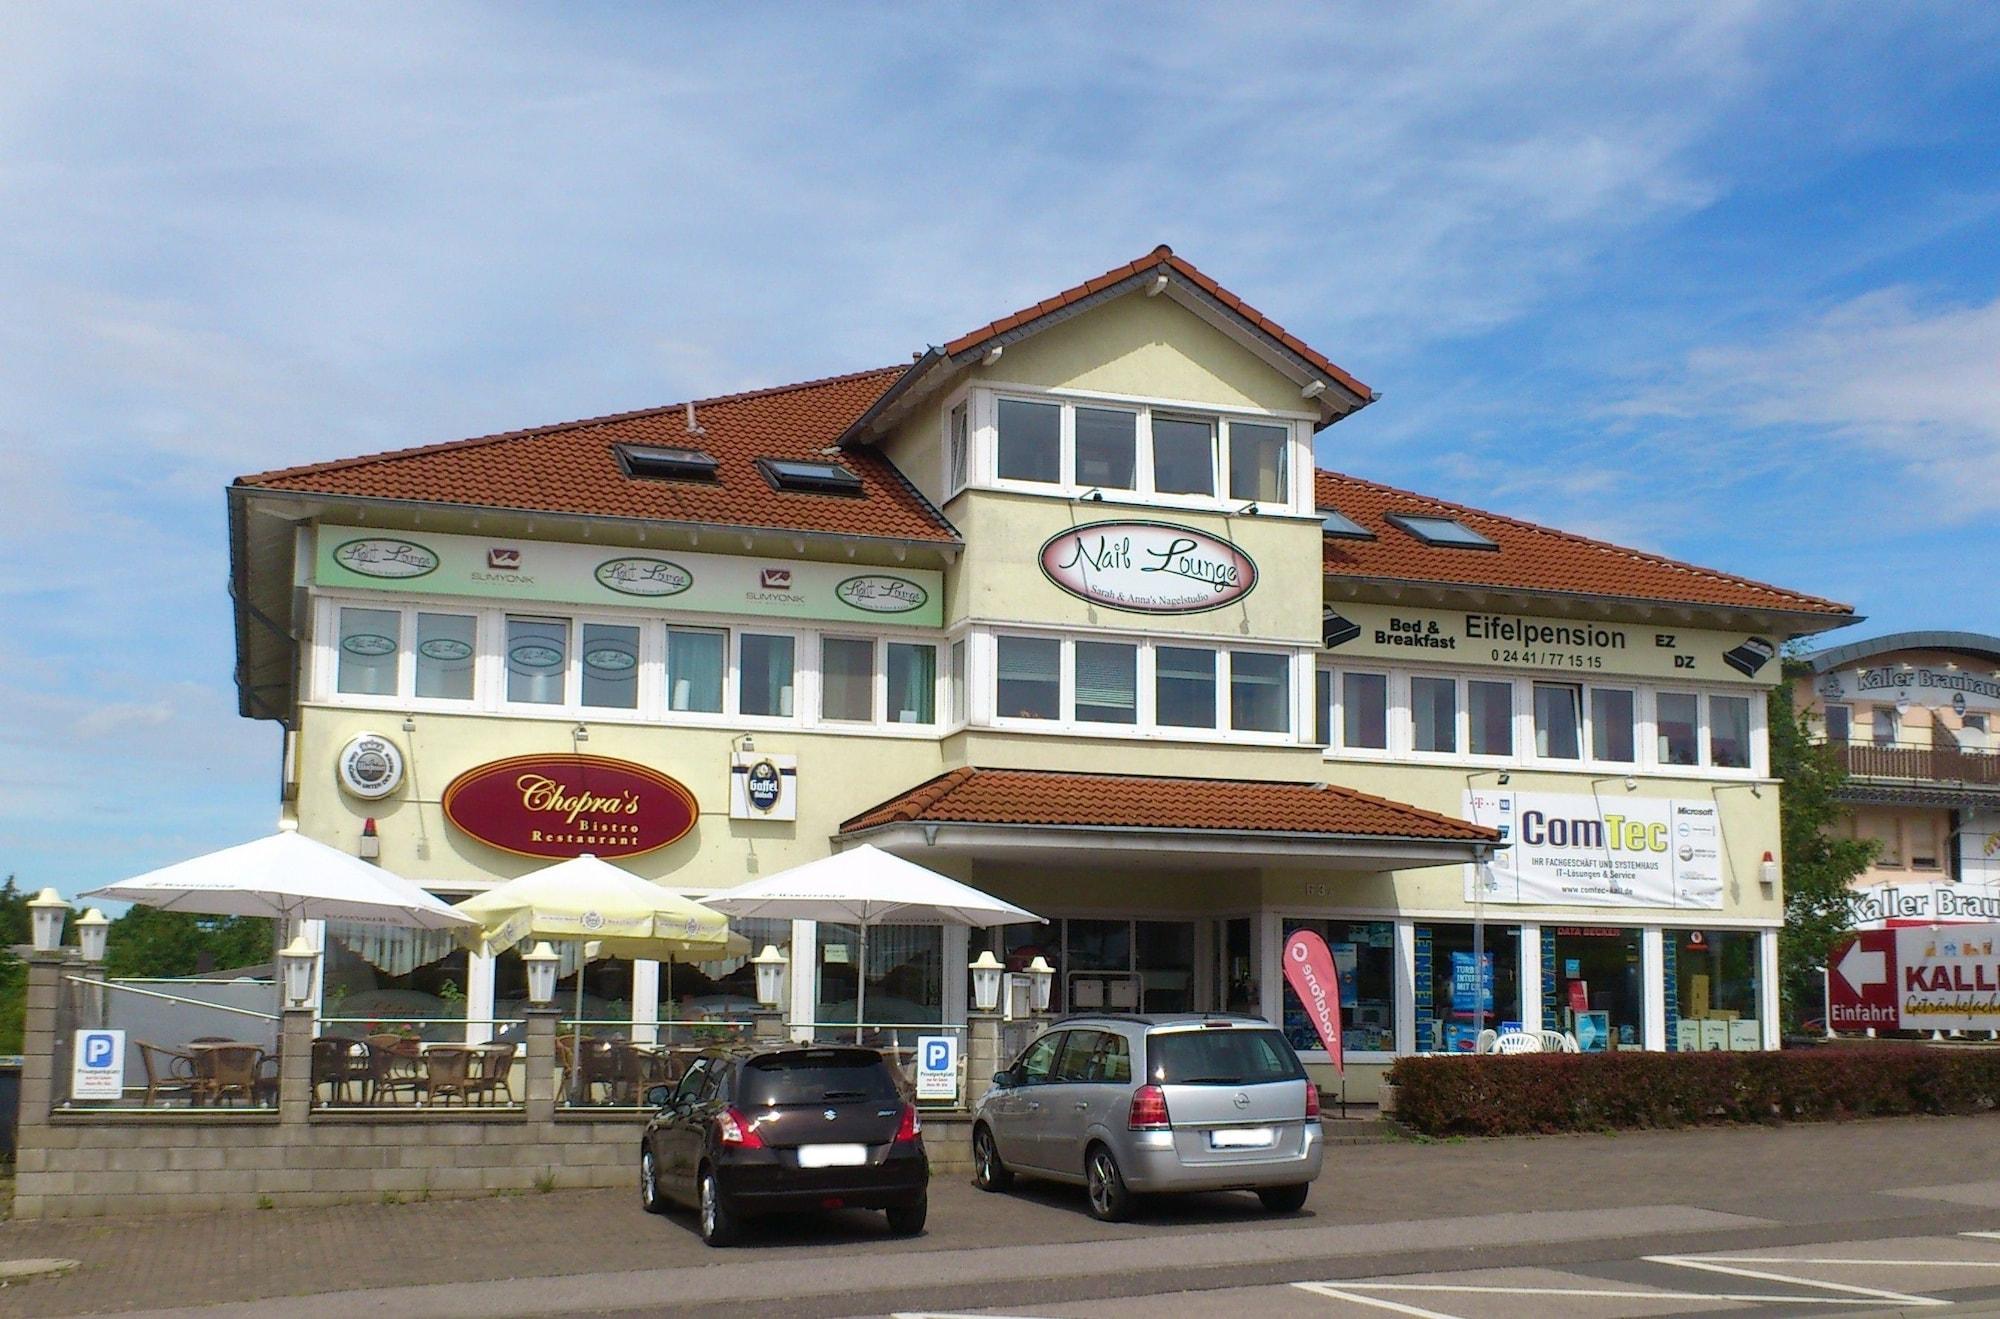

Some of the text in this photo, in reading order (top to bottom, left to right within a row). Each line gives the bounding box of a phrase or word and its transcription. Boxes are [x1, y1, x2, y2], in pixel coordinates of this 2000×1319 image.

[1058, 535, 1241, 593] Nail Lounge
[1090, 584, 1209, 607] Sarah & Anna's Nagelstudio
[1390, 618, 1440, 634] Bed &
[1465, 614, 1626, 649] Eifelpension
[1375, 631, 1456, 649] Breakfast
[1655, 634, 1676, 649] EZ
[1491, 649, 1499, 661] 0
[1503, 650, 1518, 662] 24
[1522, 652, 1536, 664] 41
[1549, 653, 1564, 665] 77
[1569, 655, 1583, 667] 15
[1588, 656, 1602, 668] 15
[1674, 655, 1695, 669] DZ
[1858, 667, 1914, 691] Kaller
[750, 779, 779, 793] Gaffel
[1677, 806, 1714, 817] Microsoft
[579, 820, 639, 833] Bistro
[532, 830, 639, 846] Restaurant
[1531, 857, 1544, 866] IHR
[1615, 860, 1659, 871] SYSTEMHAUS
[1610, 869, 1636, 879] Service
[1846, 887, 1929, 924] Kaller
[1541, 927, 1557, 1031] OFTWARE
[1905, 963, 2000, 992] KALL
[1415, 927, 1433, 1052] INTERNET
[1832, 1003, 1896, 1022] Einfahrt
